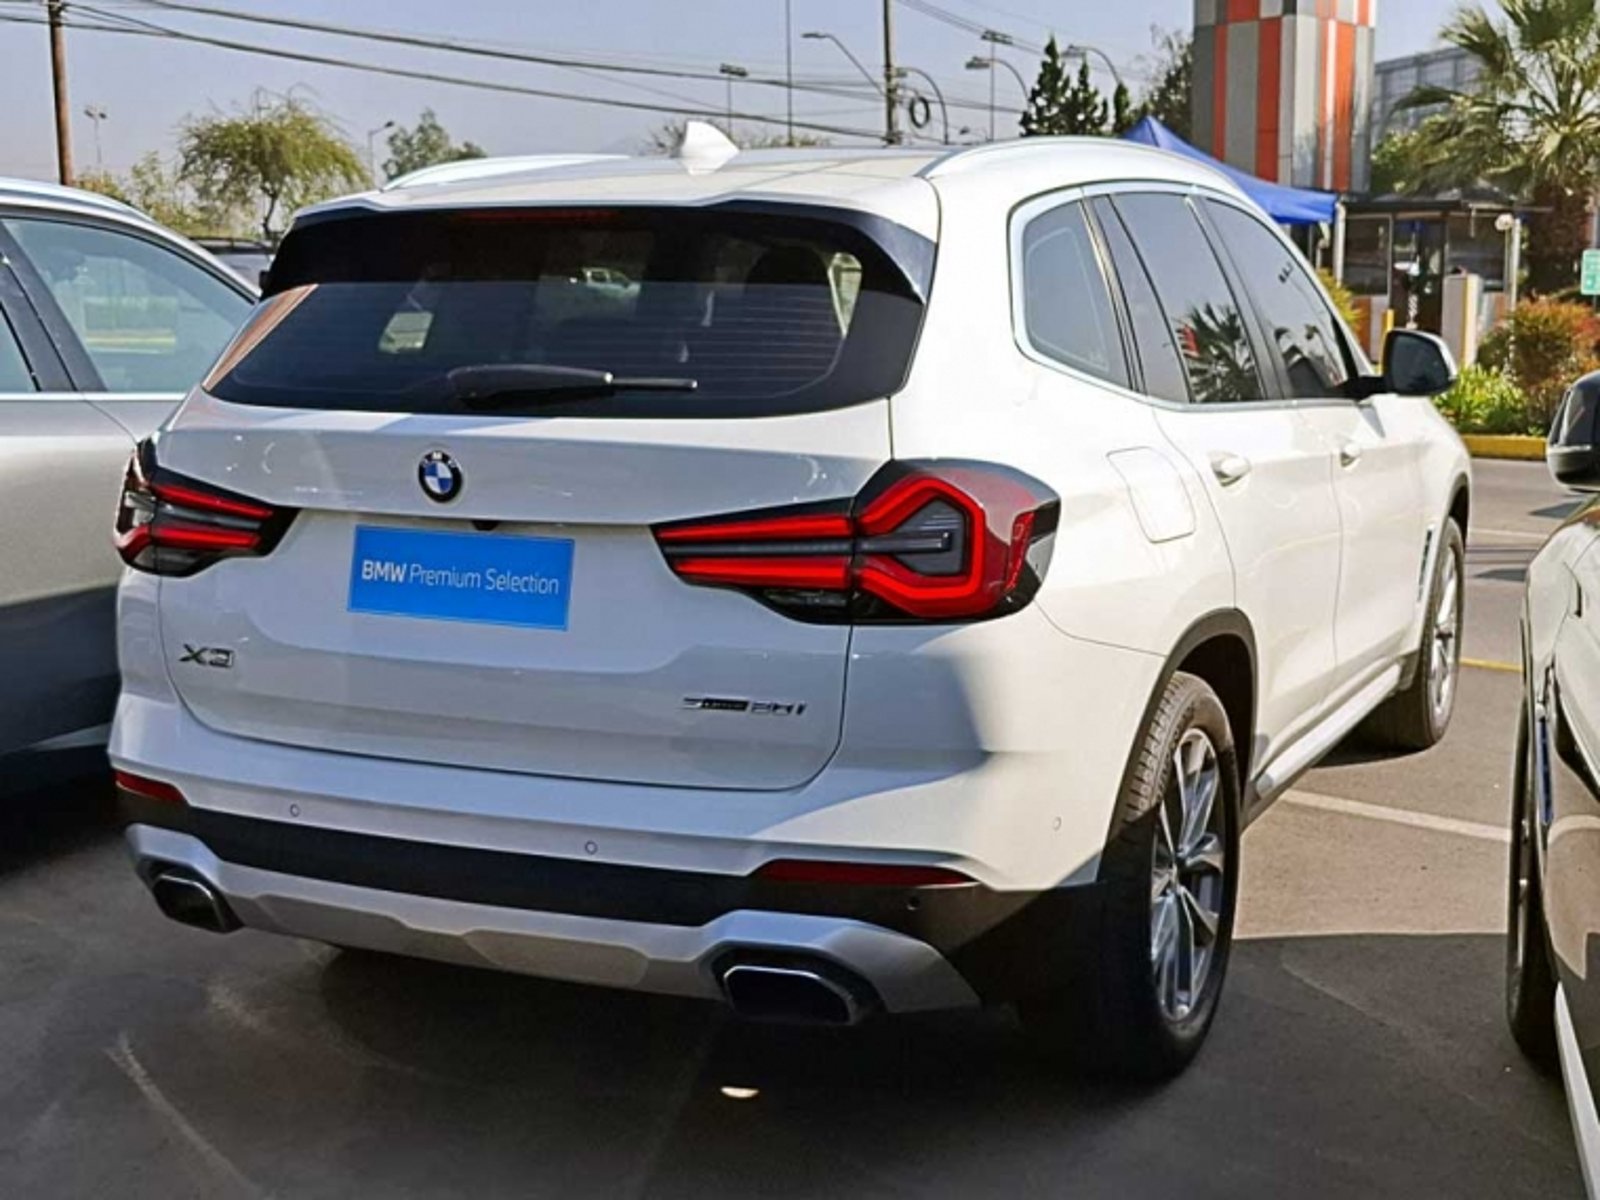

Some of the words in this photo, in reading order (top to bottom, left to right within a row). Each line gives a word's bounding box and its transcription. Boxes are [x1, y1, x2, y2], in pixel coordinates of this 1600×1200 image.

[362, 559, 407, 584] BMW
[409, 563, 481, 589] Premium
[484, 566, 560, 596] Selection
[179, 643, 235, 669] X3
